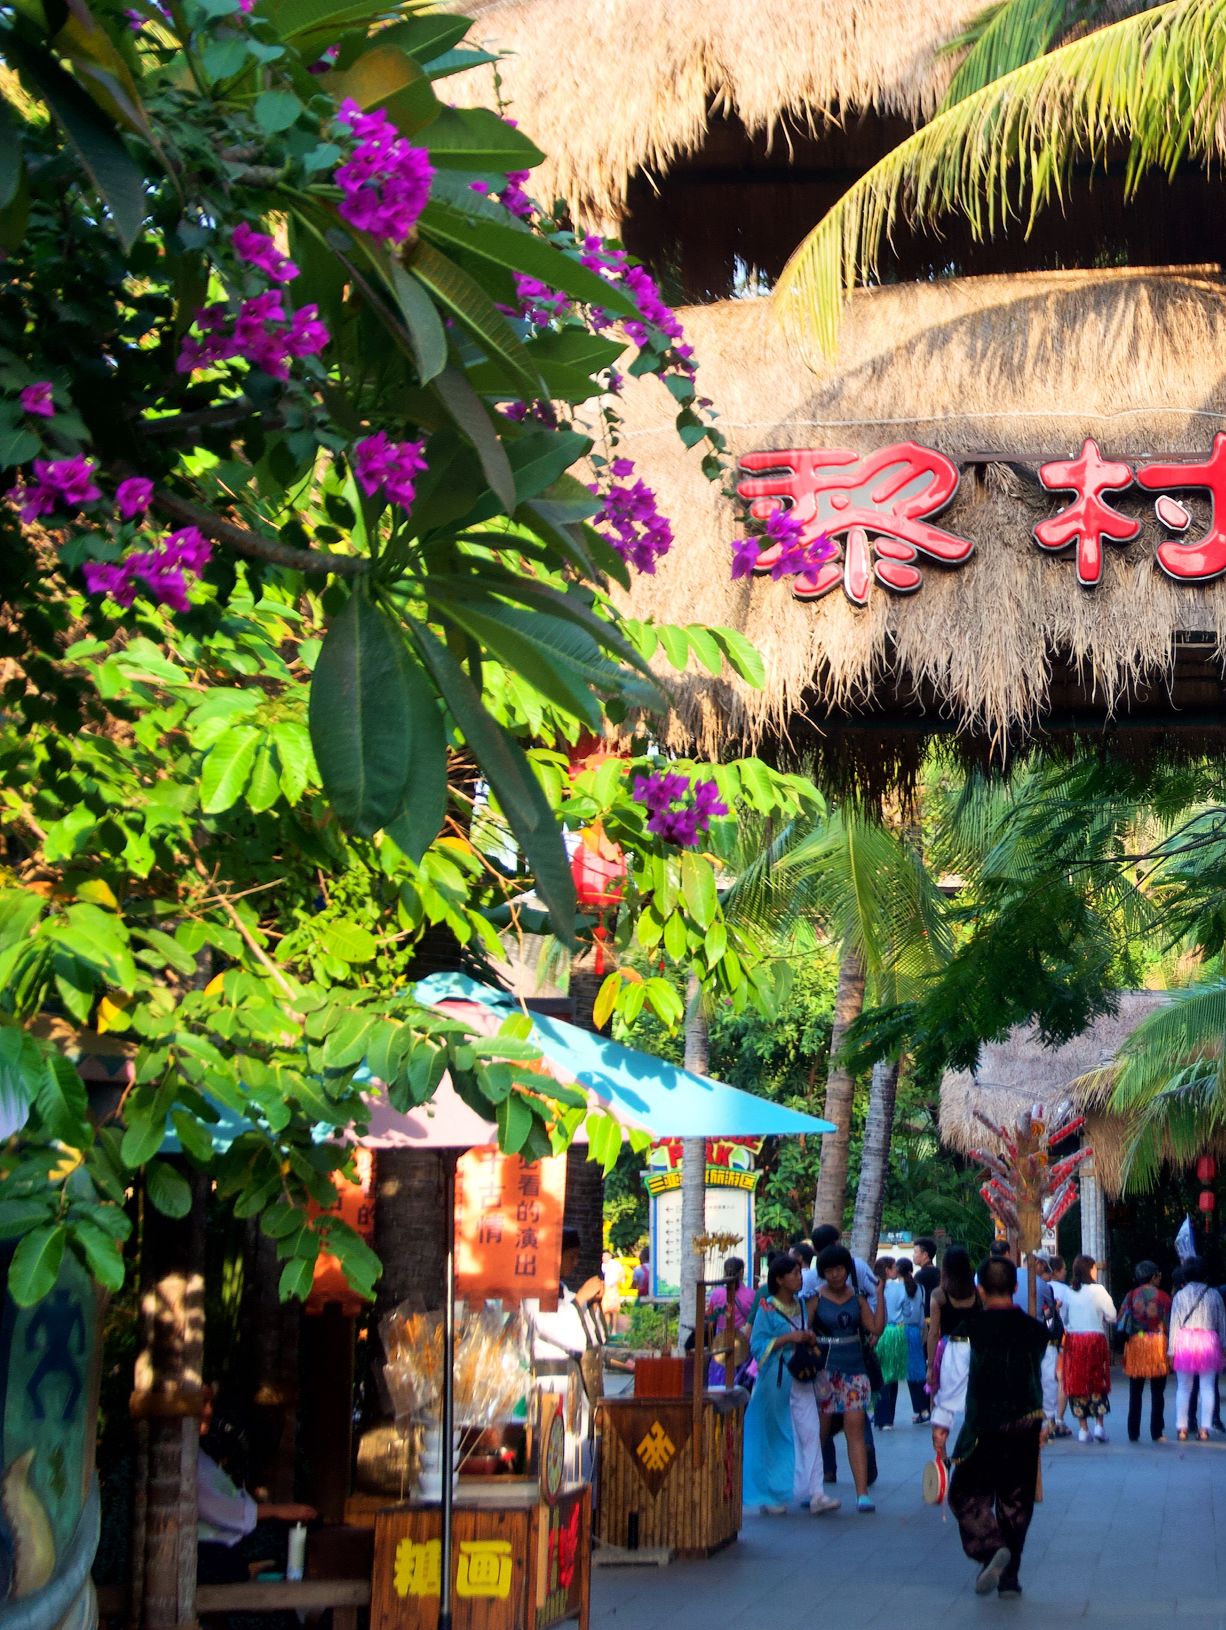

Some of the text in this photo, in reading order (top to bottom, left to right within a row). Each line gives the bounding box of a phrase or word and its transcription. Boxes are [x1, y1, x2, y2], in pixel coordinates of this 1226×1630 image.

[667, 1142, 734, 1168] PRK
[648, 1169, 756, 1193] 三亚旅游区
